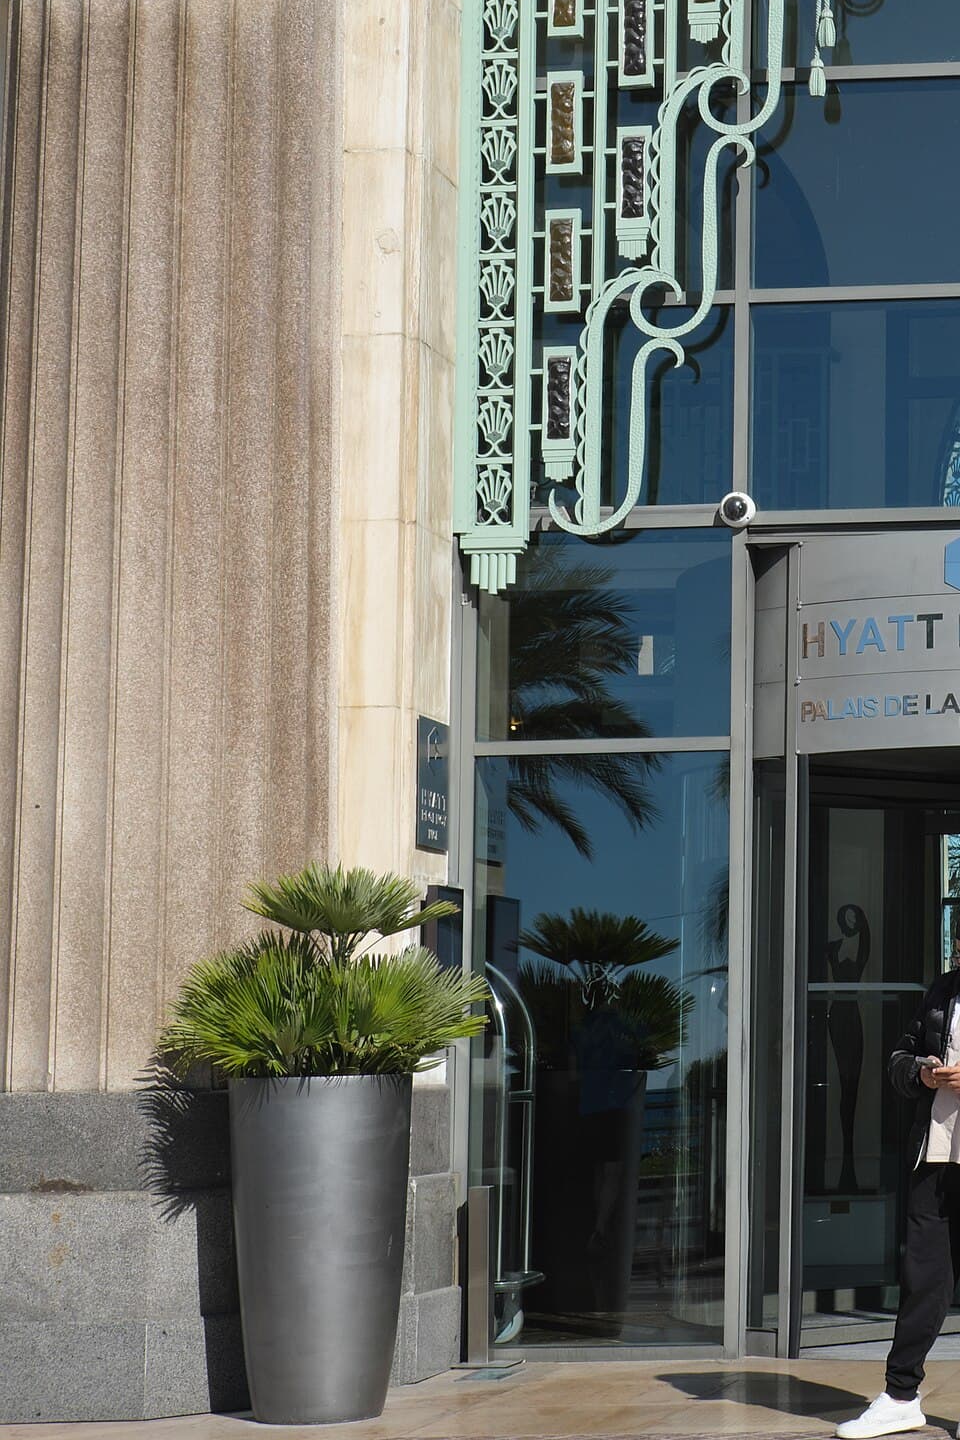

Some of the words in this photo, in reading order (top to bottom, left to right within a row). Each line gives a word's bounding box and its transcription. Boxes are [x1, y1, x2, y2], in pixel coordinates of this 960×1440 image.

[802, 612, 944, 659] HYATT
[800, 694, 879, 723] PALAIS
[884, 693, 919, 717] DE
[925, 691, 960, 715] LA
